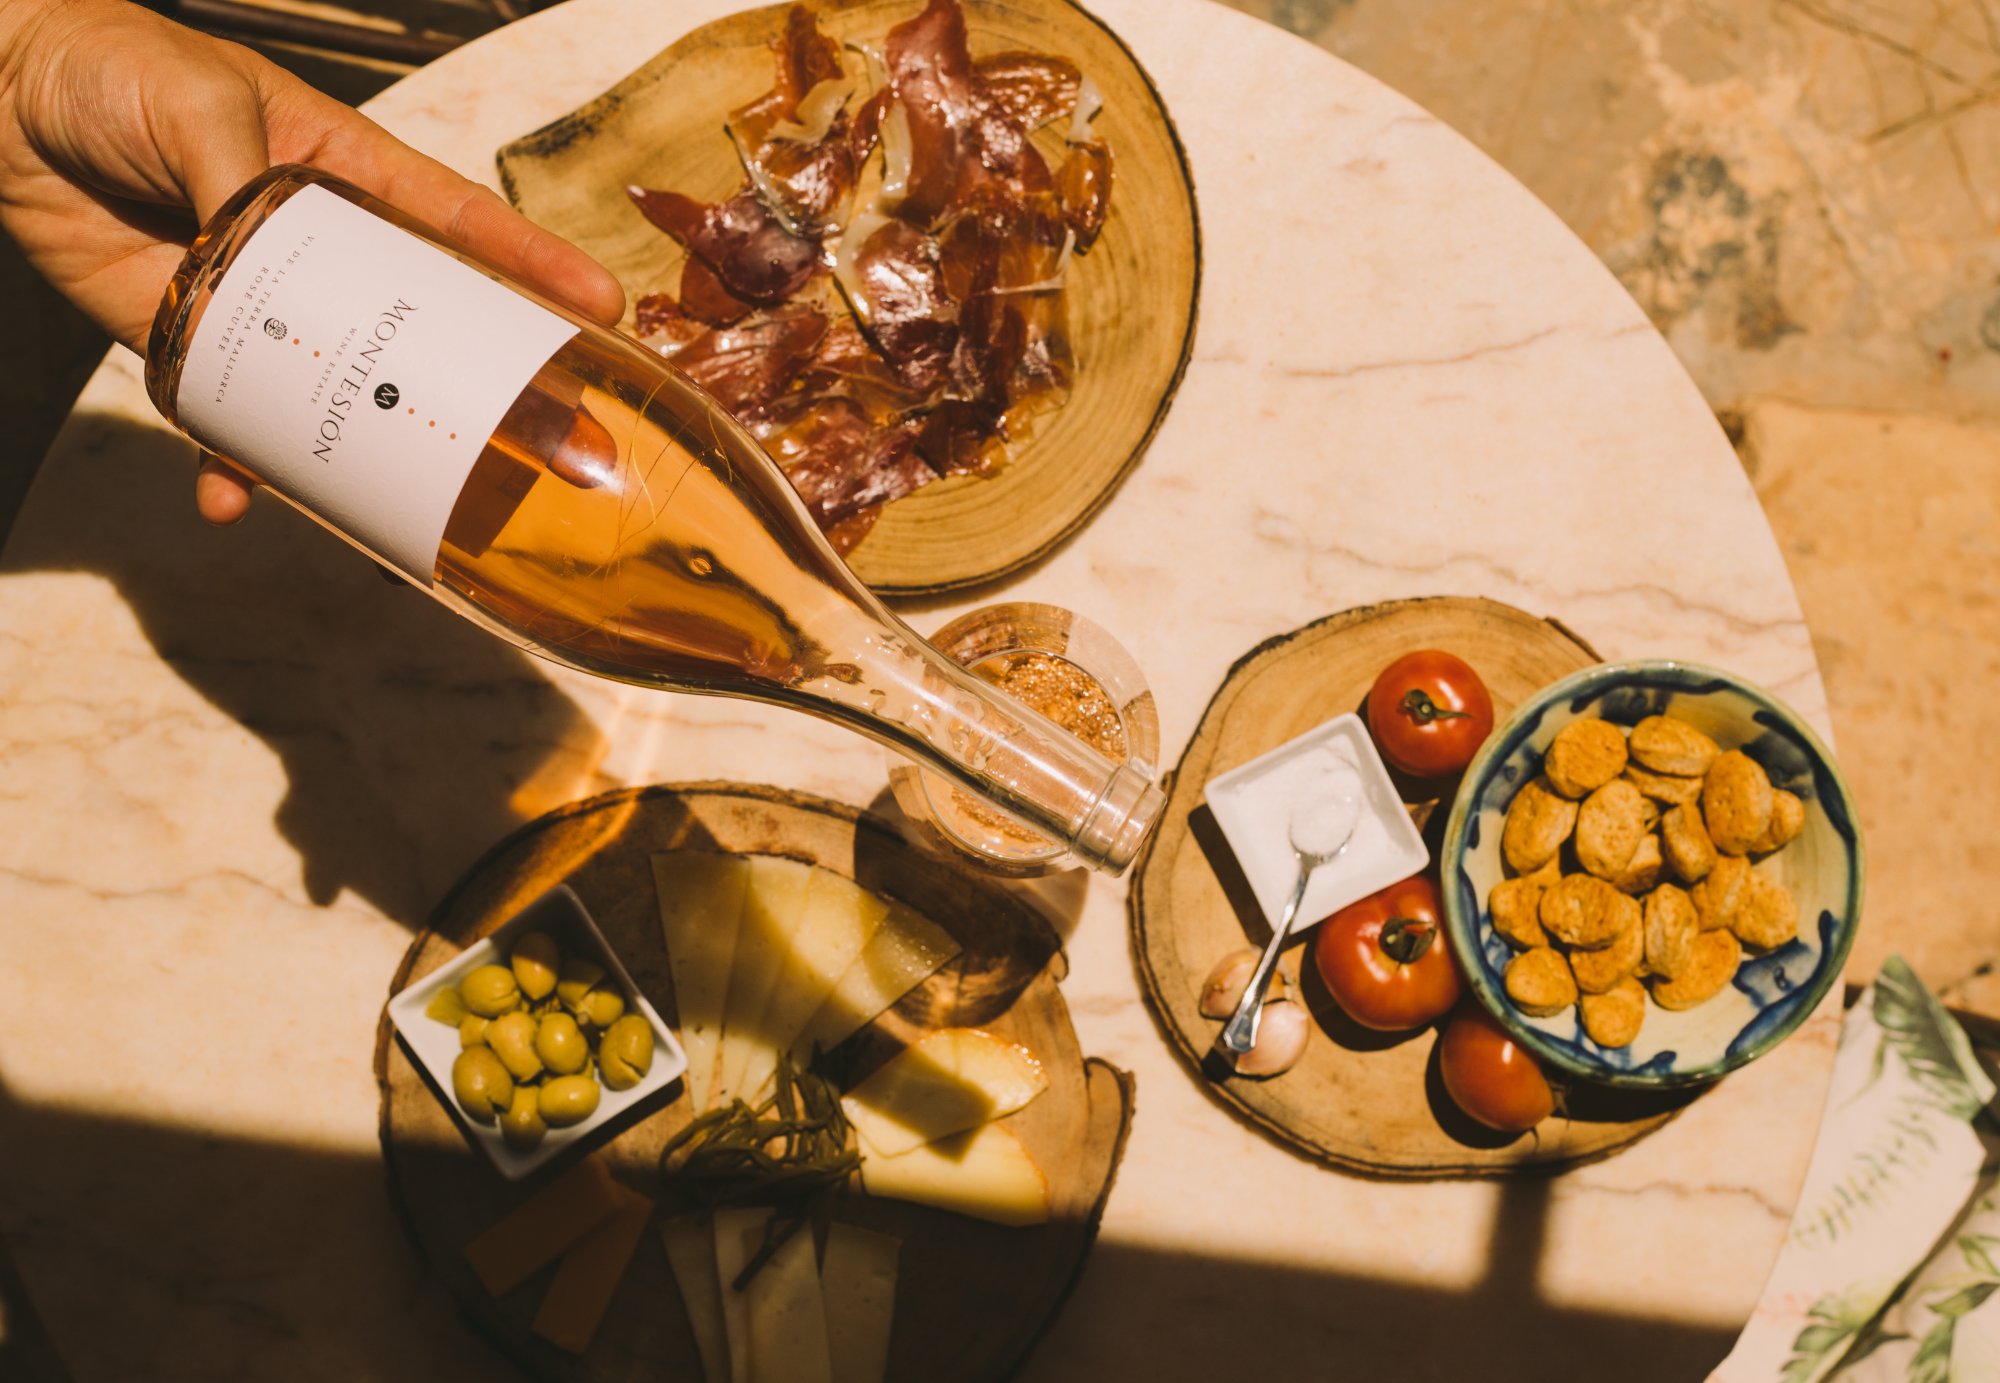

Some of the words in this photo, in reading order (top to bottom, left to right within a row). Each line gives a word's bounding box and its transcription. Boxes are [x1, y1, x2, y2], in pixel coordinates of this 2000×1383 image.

[301, 235, 315, 247] VI
[286, 250, 300, 264] DE
[271, 270, 286, 284] LA
[244, 290, 272, 332] TERRA
[336, 327, 357, 356] WINE
[215, 337, 245, 404] MALLORCA
[310, 361, 336, 404] ESTATE
[312, 298, 419, 463] MONTESIÓN
[375, 386, 399, 406] M
